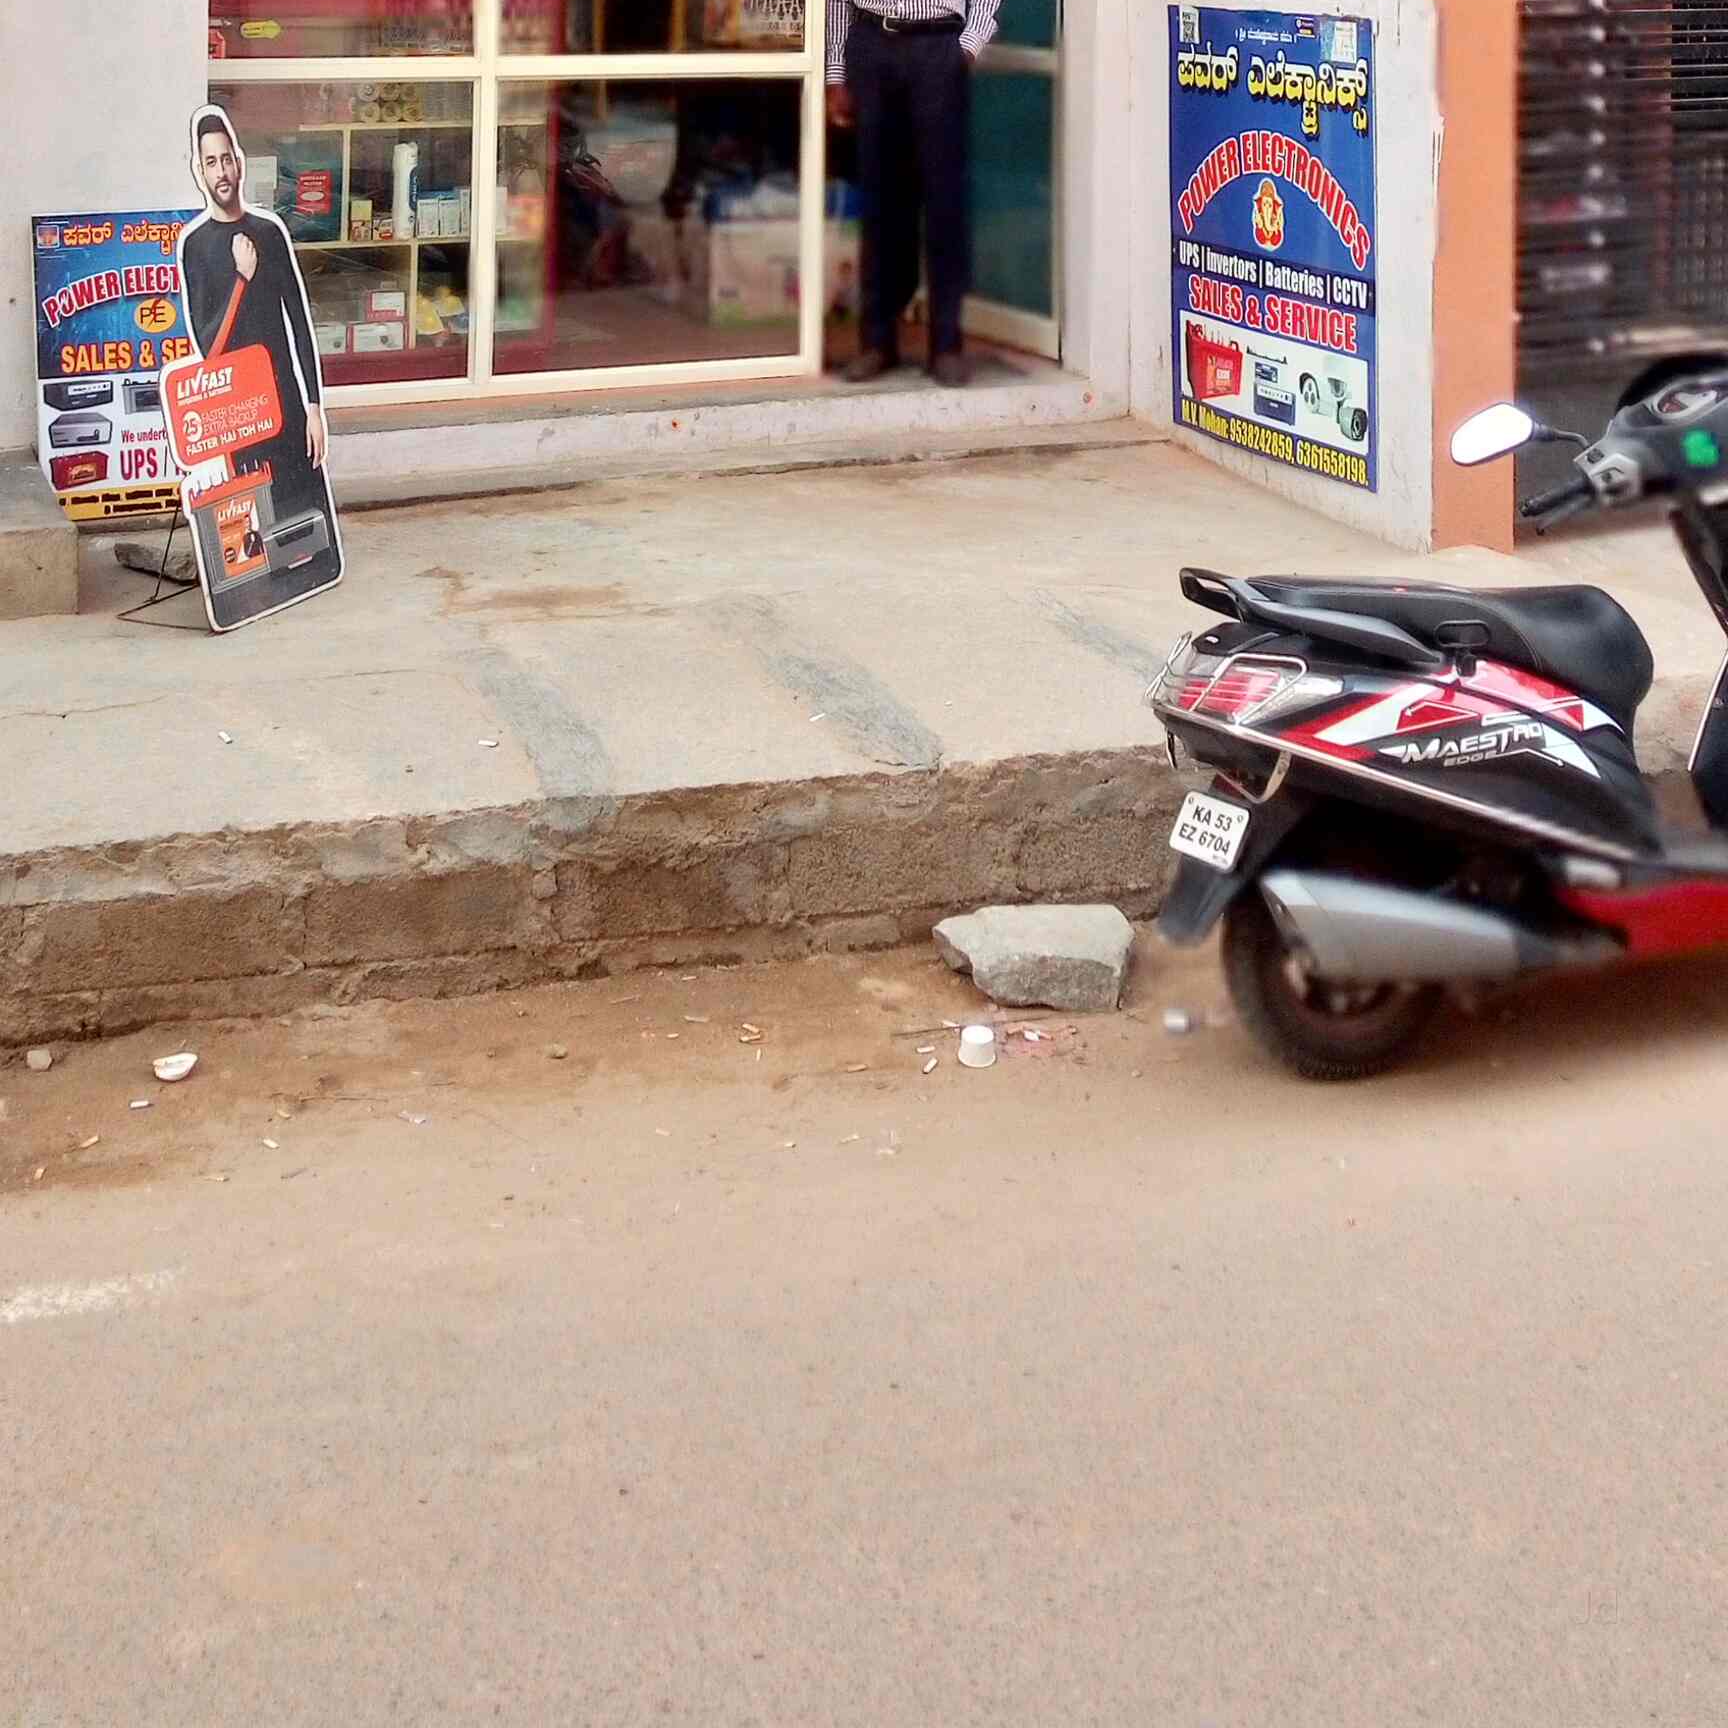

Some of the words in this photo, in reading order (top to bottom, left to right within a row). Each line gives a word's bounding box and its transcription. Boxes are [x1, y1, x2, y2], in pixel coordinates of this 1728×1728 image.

[1178, 43, 1239, 89] ಪವರ್
[1178, 137, 1240, 234] POWER
[1240, 130, 1370, 271] ELECTRONICS
[63, 222, 113, 246] ಪವರ್
[1180, 240, 1200, 268] UPS
[1265, 261, 1324, 299] Batteries
[1332, 276, 1368, 309] CCTV
[42, 269, 121, 328] POWER
[121, 264, 181, 297] ELECT
[1188, 274, 1244, 324] SALES
[1245, 295, 1261, 329] &
[1264, 294, 1358, 354] SERVICE
[61, 341, 133, 373] SALES
[139, 340, 156, 369] &
[161, 336, 196, 364] SE
[176, 367, 233, 399] LIVFAST
[121, 430, 135, 443] We
[186, 436, 219, 456] FASTER
[220, 430, 237, 445] HAI
[239, 424, 256, 439] TOH
[120, 447, 158, 481] UPS
[1401, 722, 1542, 764] MAESTRO
[1192, 805, 1212, 826] KA
[1215, 814, 1232, 832] 53
[1178, 823, 1197, 842] EZ
[1198, 830, 1231, 856] 6704
